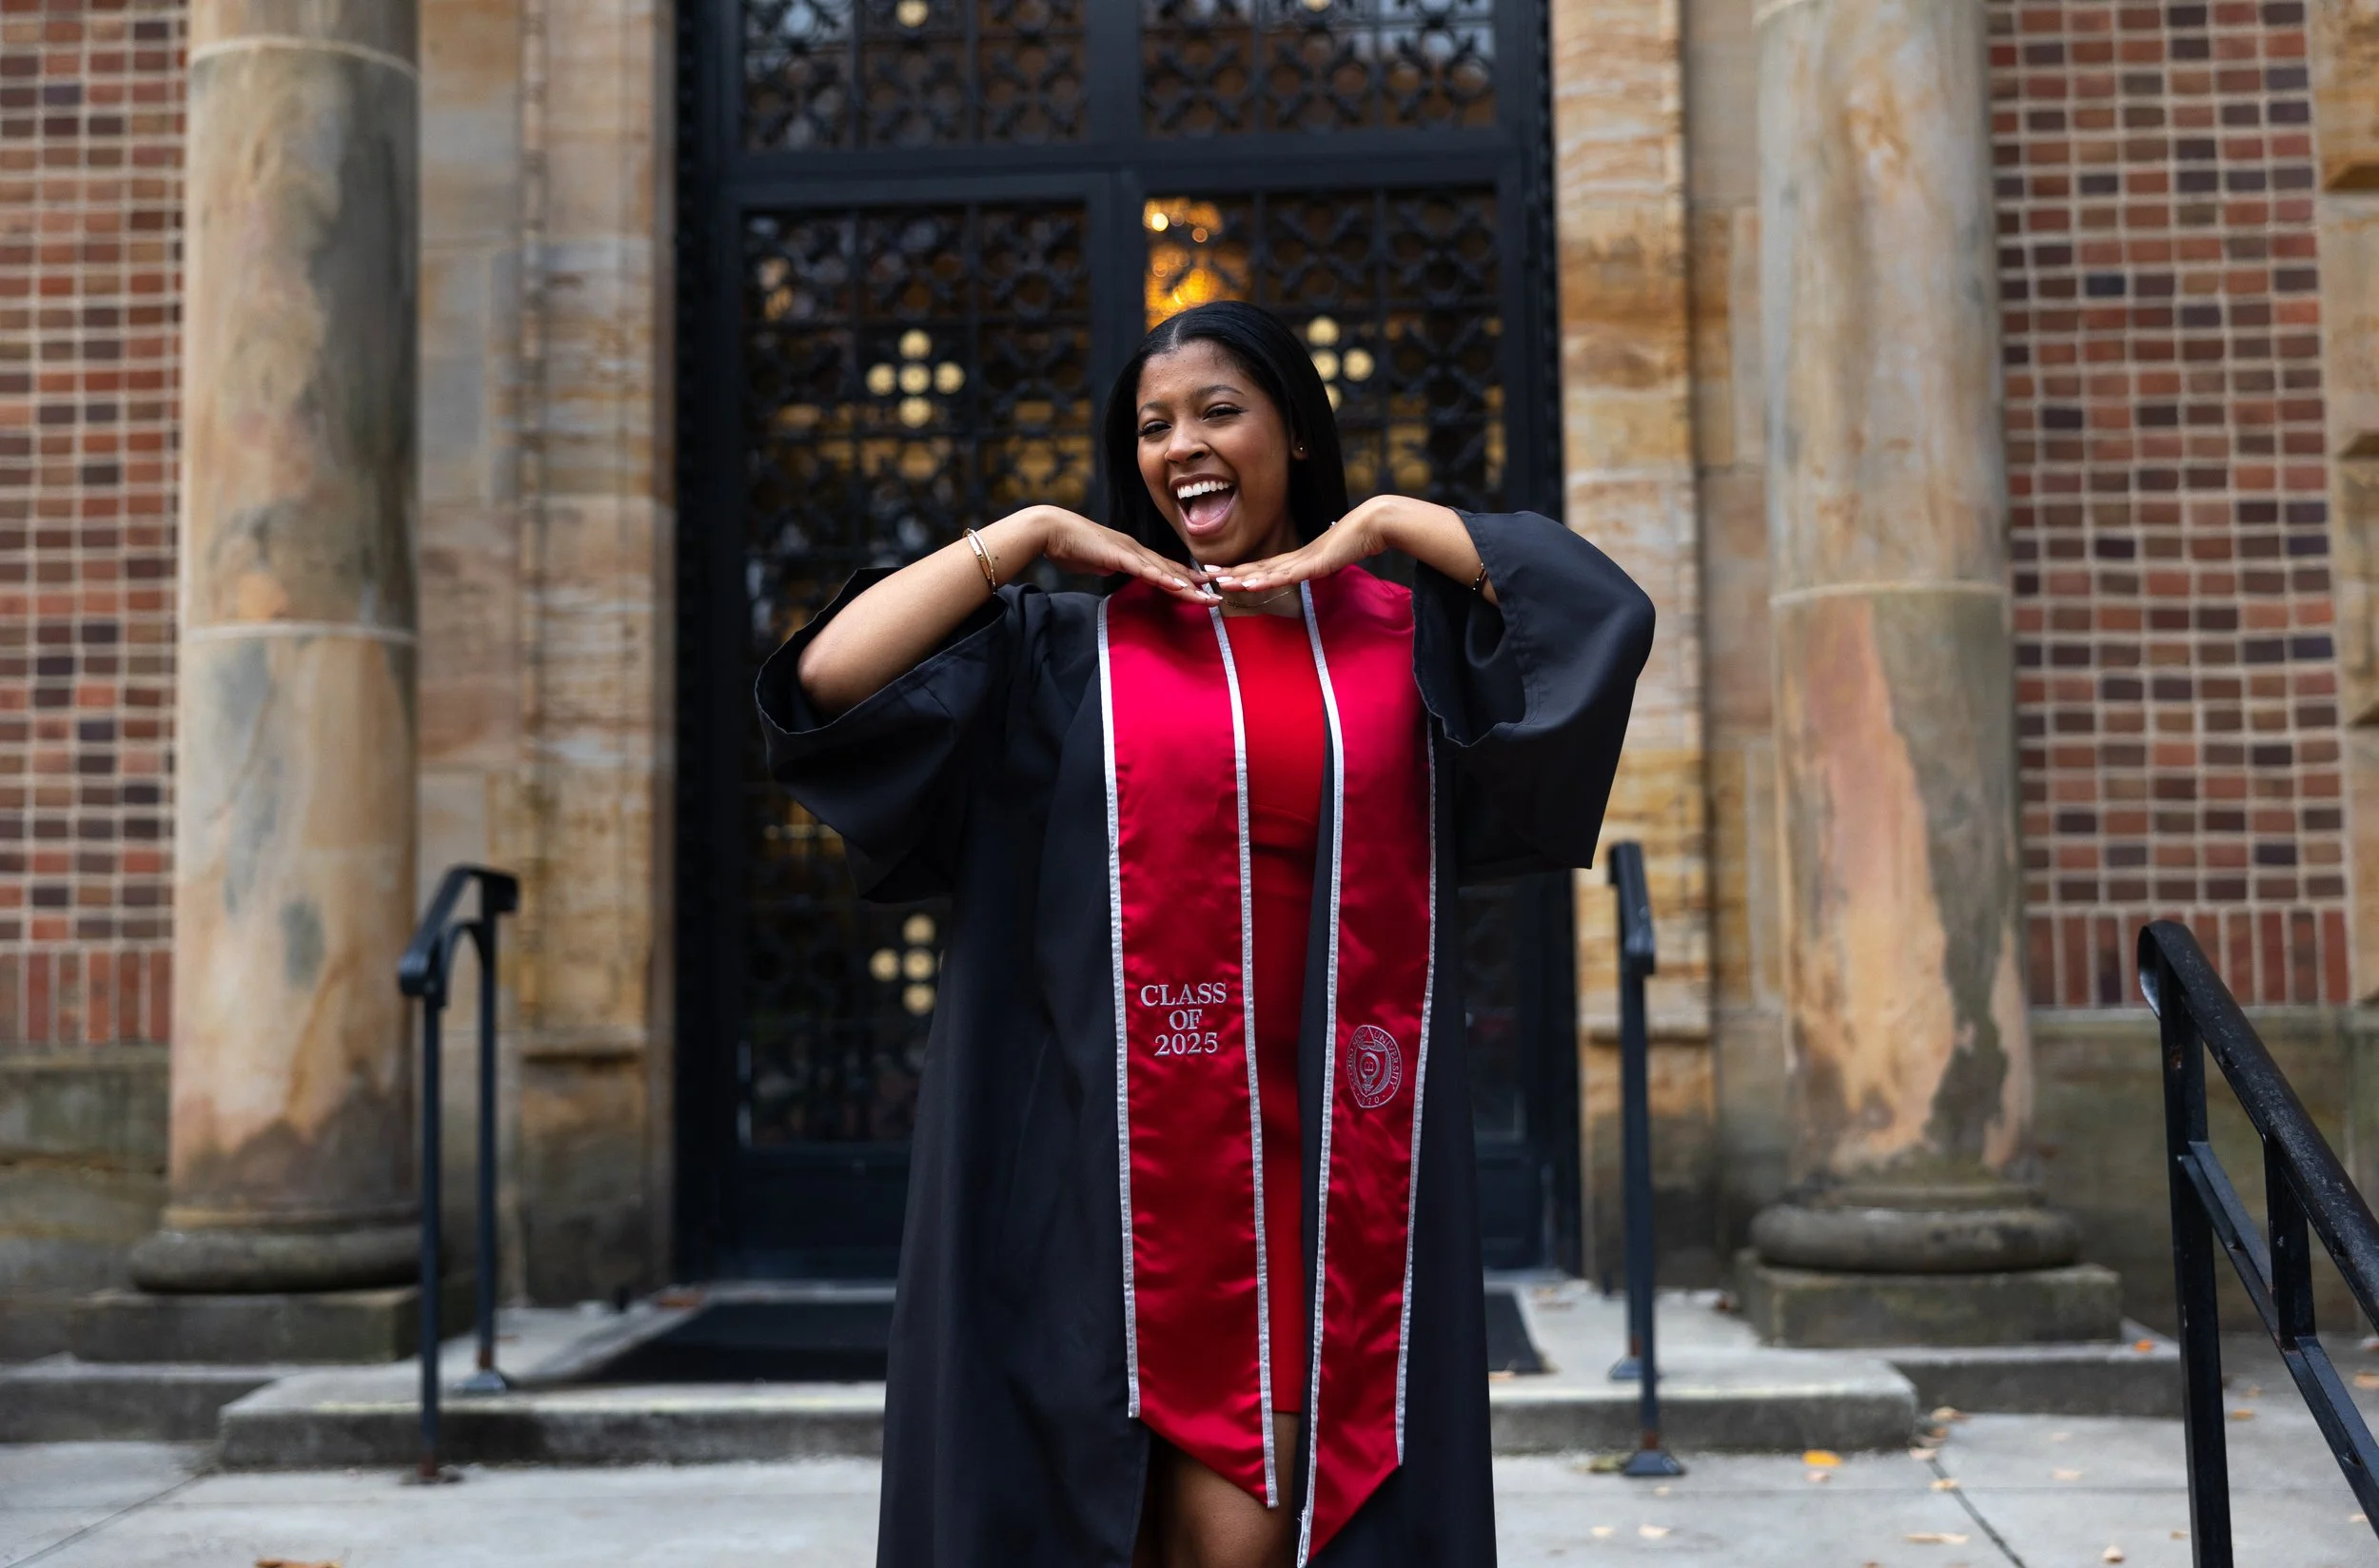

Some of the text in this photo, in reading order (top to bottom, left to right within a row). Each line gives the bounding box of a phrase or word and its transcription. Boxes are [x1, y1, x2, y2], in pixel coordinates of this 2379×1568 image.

[1140, 982, 1227, 1007] CLASS
[1169, 1009, 1203, 1030] OF
[1154, 1032, 1218, 1056] 2025
[1374, 1030, 1400, 1090] UNIVERSITY
